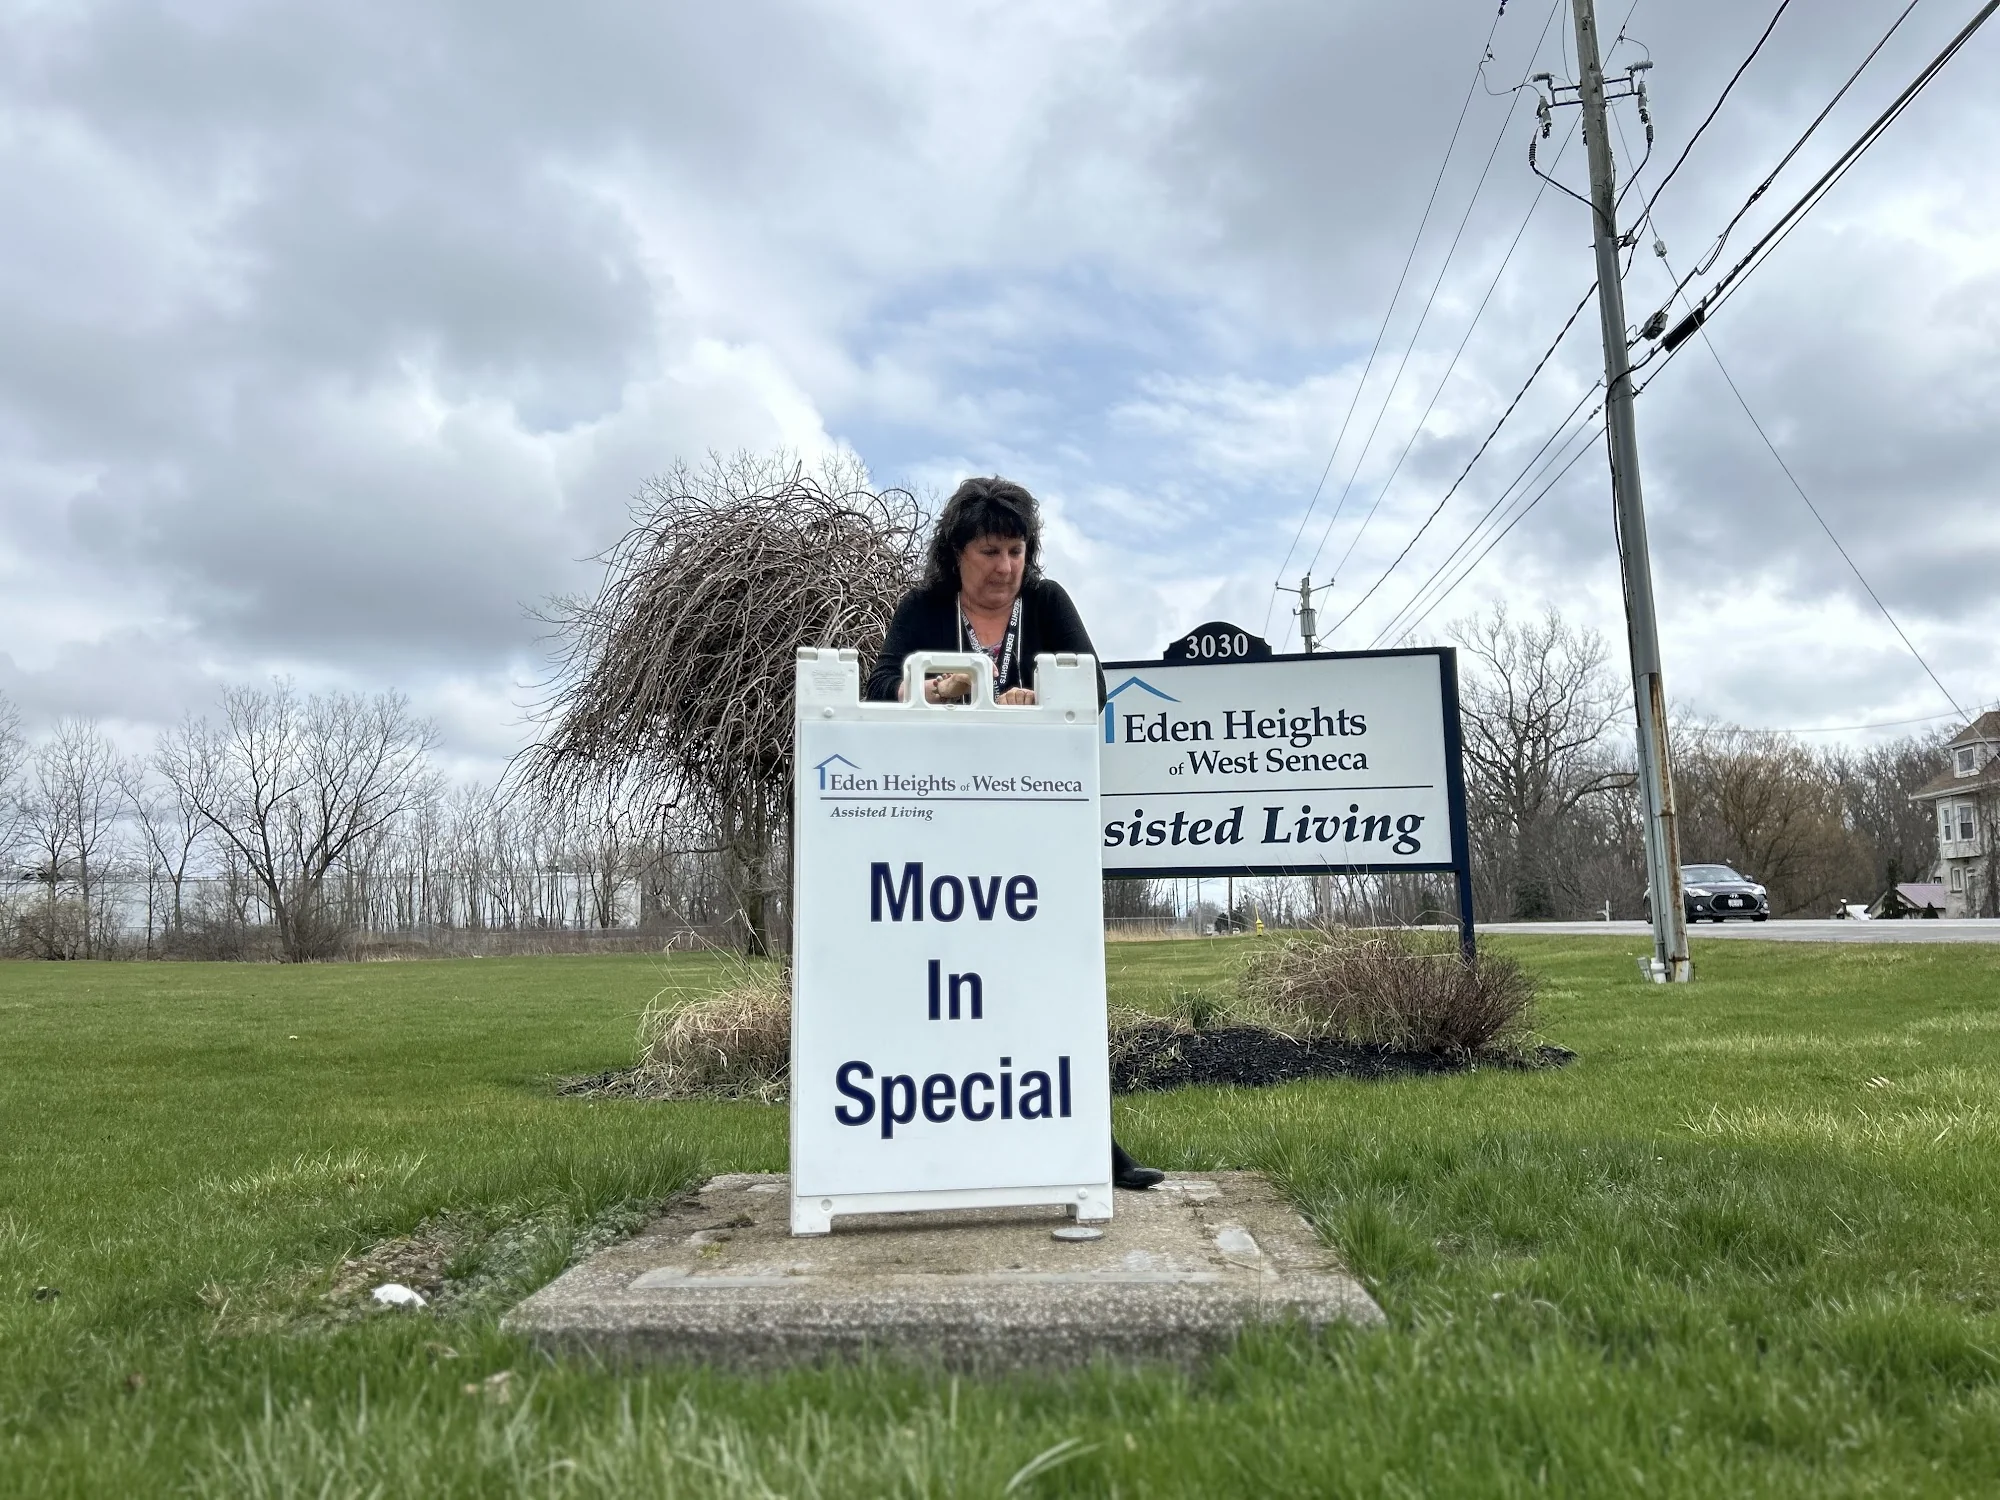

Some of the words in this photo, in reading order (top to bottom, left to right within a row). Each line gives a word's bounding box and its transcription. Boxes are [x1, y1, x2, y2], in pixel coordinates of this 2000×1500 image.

[1006, 633, 1015, 653] EDEN
[1185, 633, 1249, 659] 3030
[1000, 653, 1011, 684] HEIGHTS
[1124, 712, 1214, 744] Eden
[1223, 706, 1367, 748] Heights
[1169, 762, 1184, 775] of
[1186, 750, 1258, 775] West
[1266, 748, 1369, 773] Seneca
[830, 774, 877, 791] Eden
[883, 775, 956, 796] Heights
[960, 781, 970, 792] of
[972, 776, 1016, 792] West
[1021, 776, 1082, 793] Seneca
[830, 806, 887, 819] Assisted
[891, 806, 934, 821] Living
[1104, 805, 1244, 847] sisted
[1261, 804, 1425, 855] Living
[870, 861, 1039, 923] Move
[928, 959, 983, 1020] In
[835, 1055, 1072, 1140] Special
